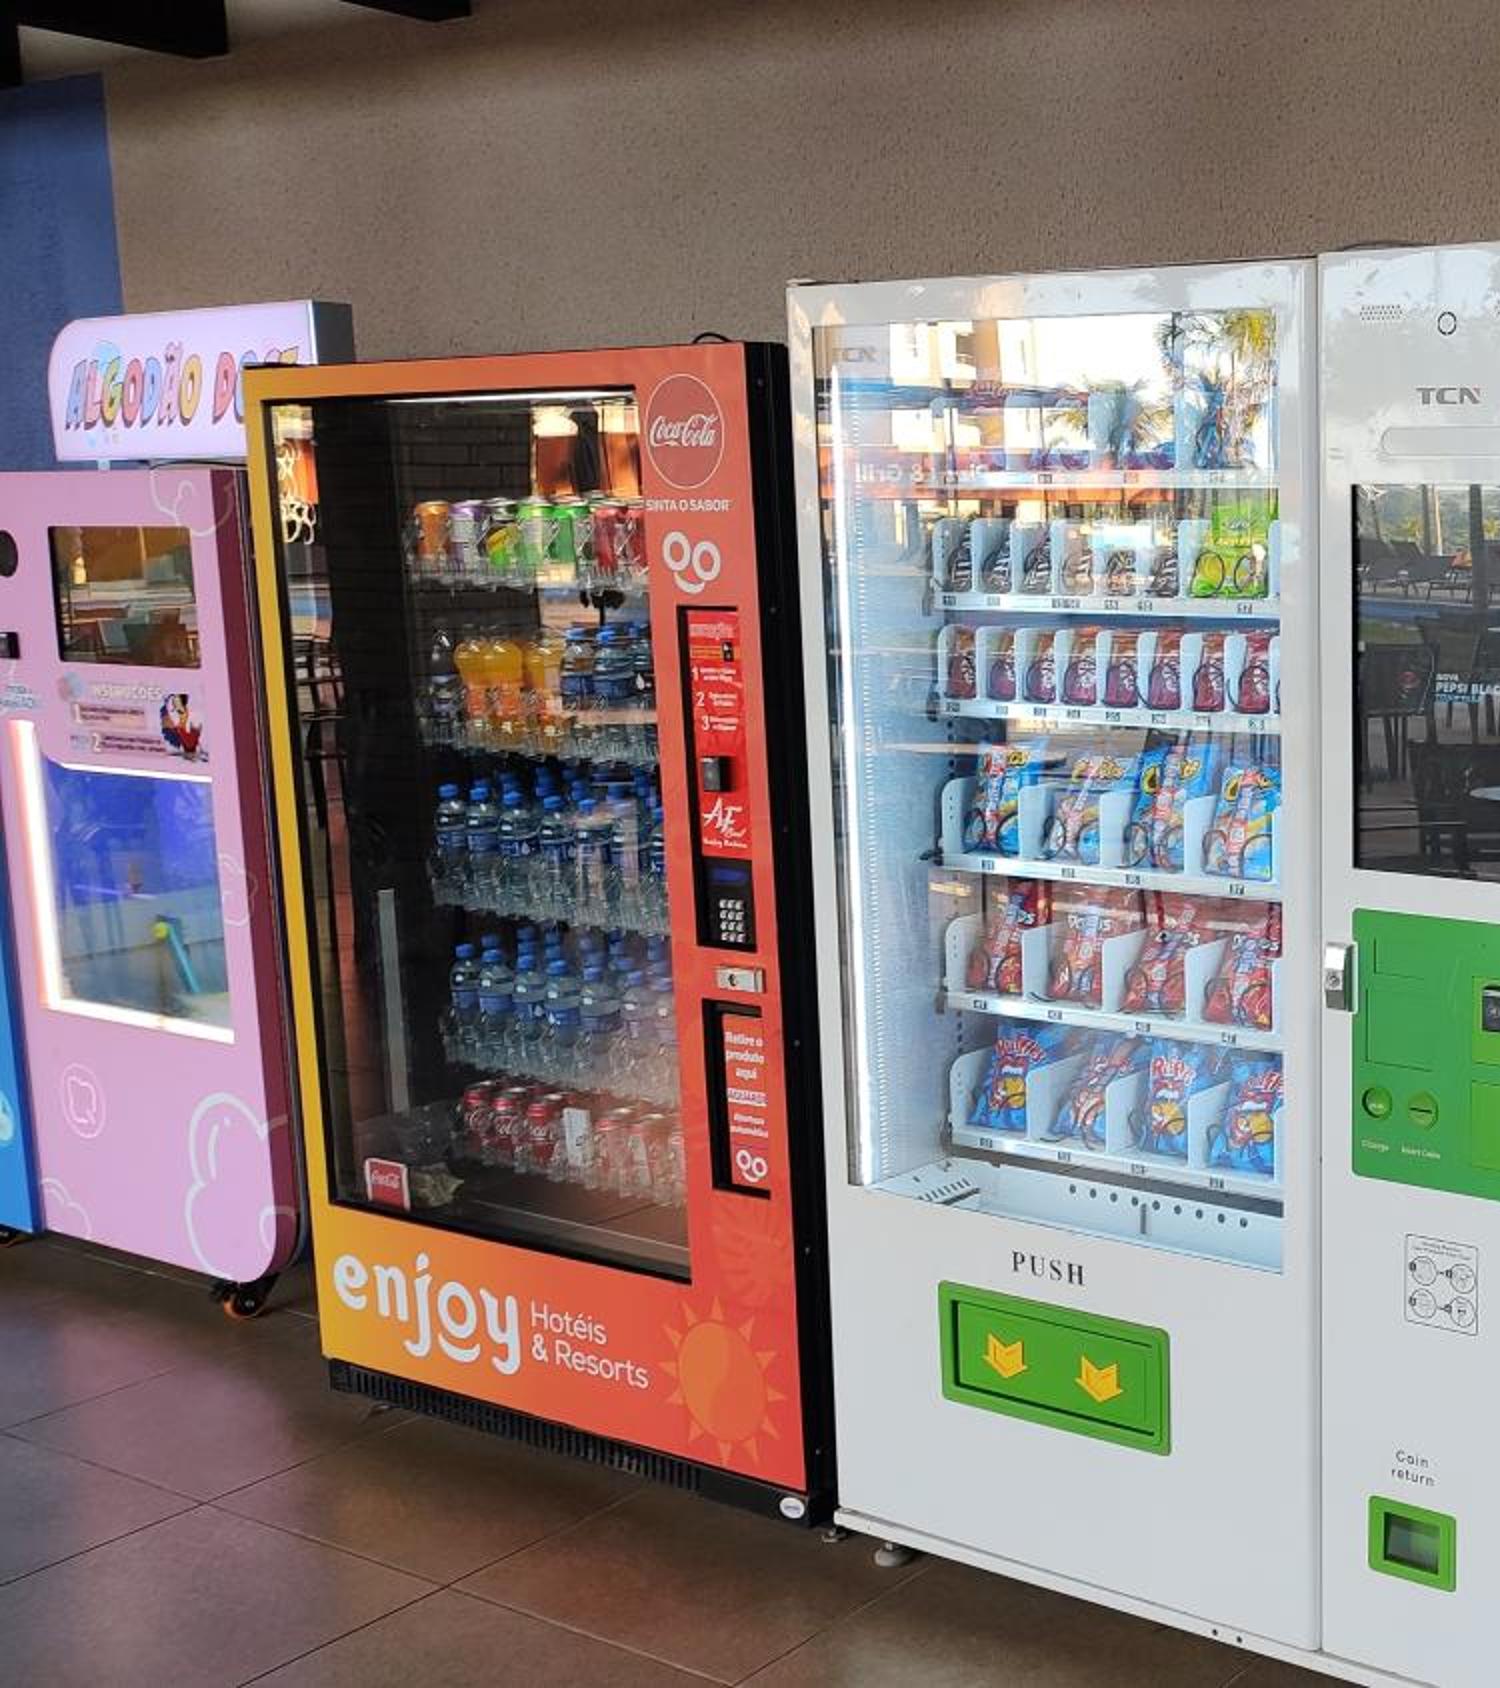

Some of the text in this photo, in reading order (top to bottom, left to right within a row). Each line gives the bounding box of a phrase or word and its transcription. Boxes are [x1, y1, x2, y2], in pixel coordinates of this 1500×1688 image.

[66, 341, 202, 430] ALGODÃO
[1416, 387, 1481, 405] TCN
[649, 414, 719, 448] Coca-Cola
[646, 499, 730, 512] SINTA O SABOR
[1436, 681, 1469, 694] PEPSI
[1012, 1251, 1085, 1286] PUSH
[333, 1252, 607, 1374] enjoy Hotéis
[532, 1333, 649, 1390] & Resorts
[1395, 1449, 1429, 1468] Coin
[1391, 1467, 1435, 1487] return
